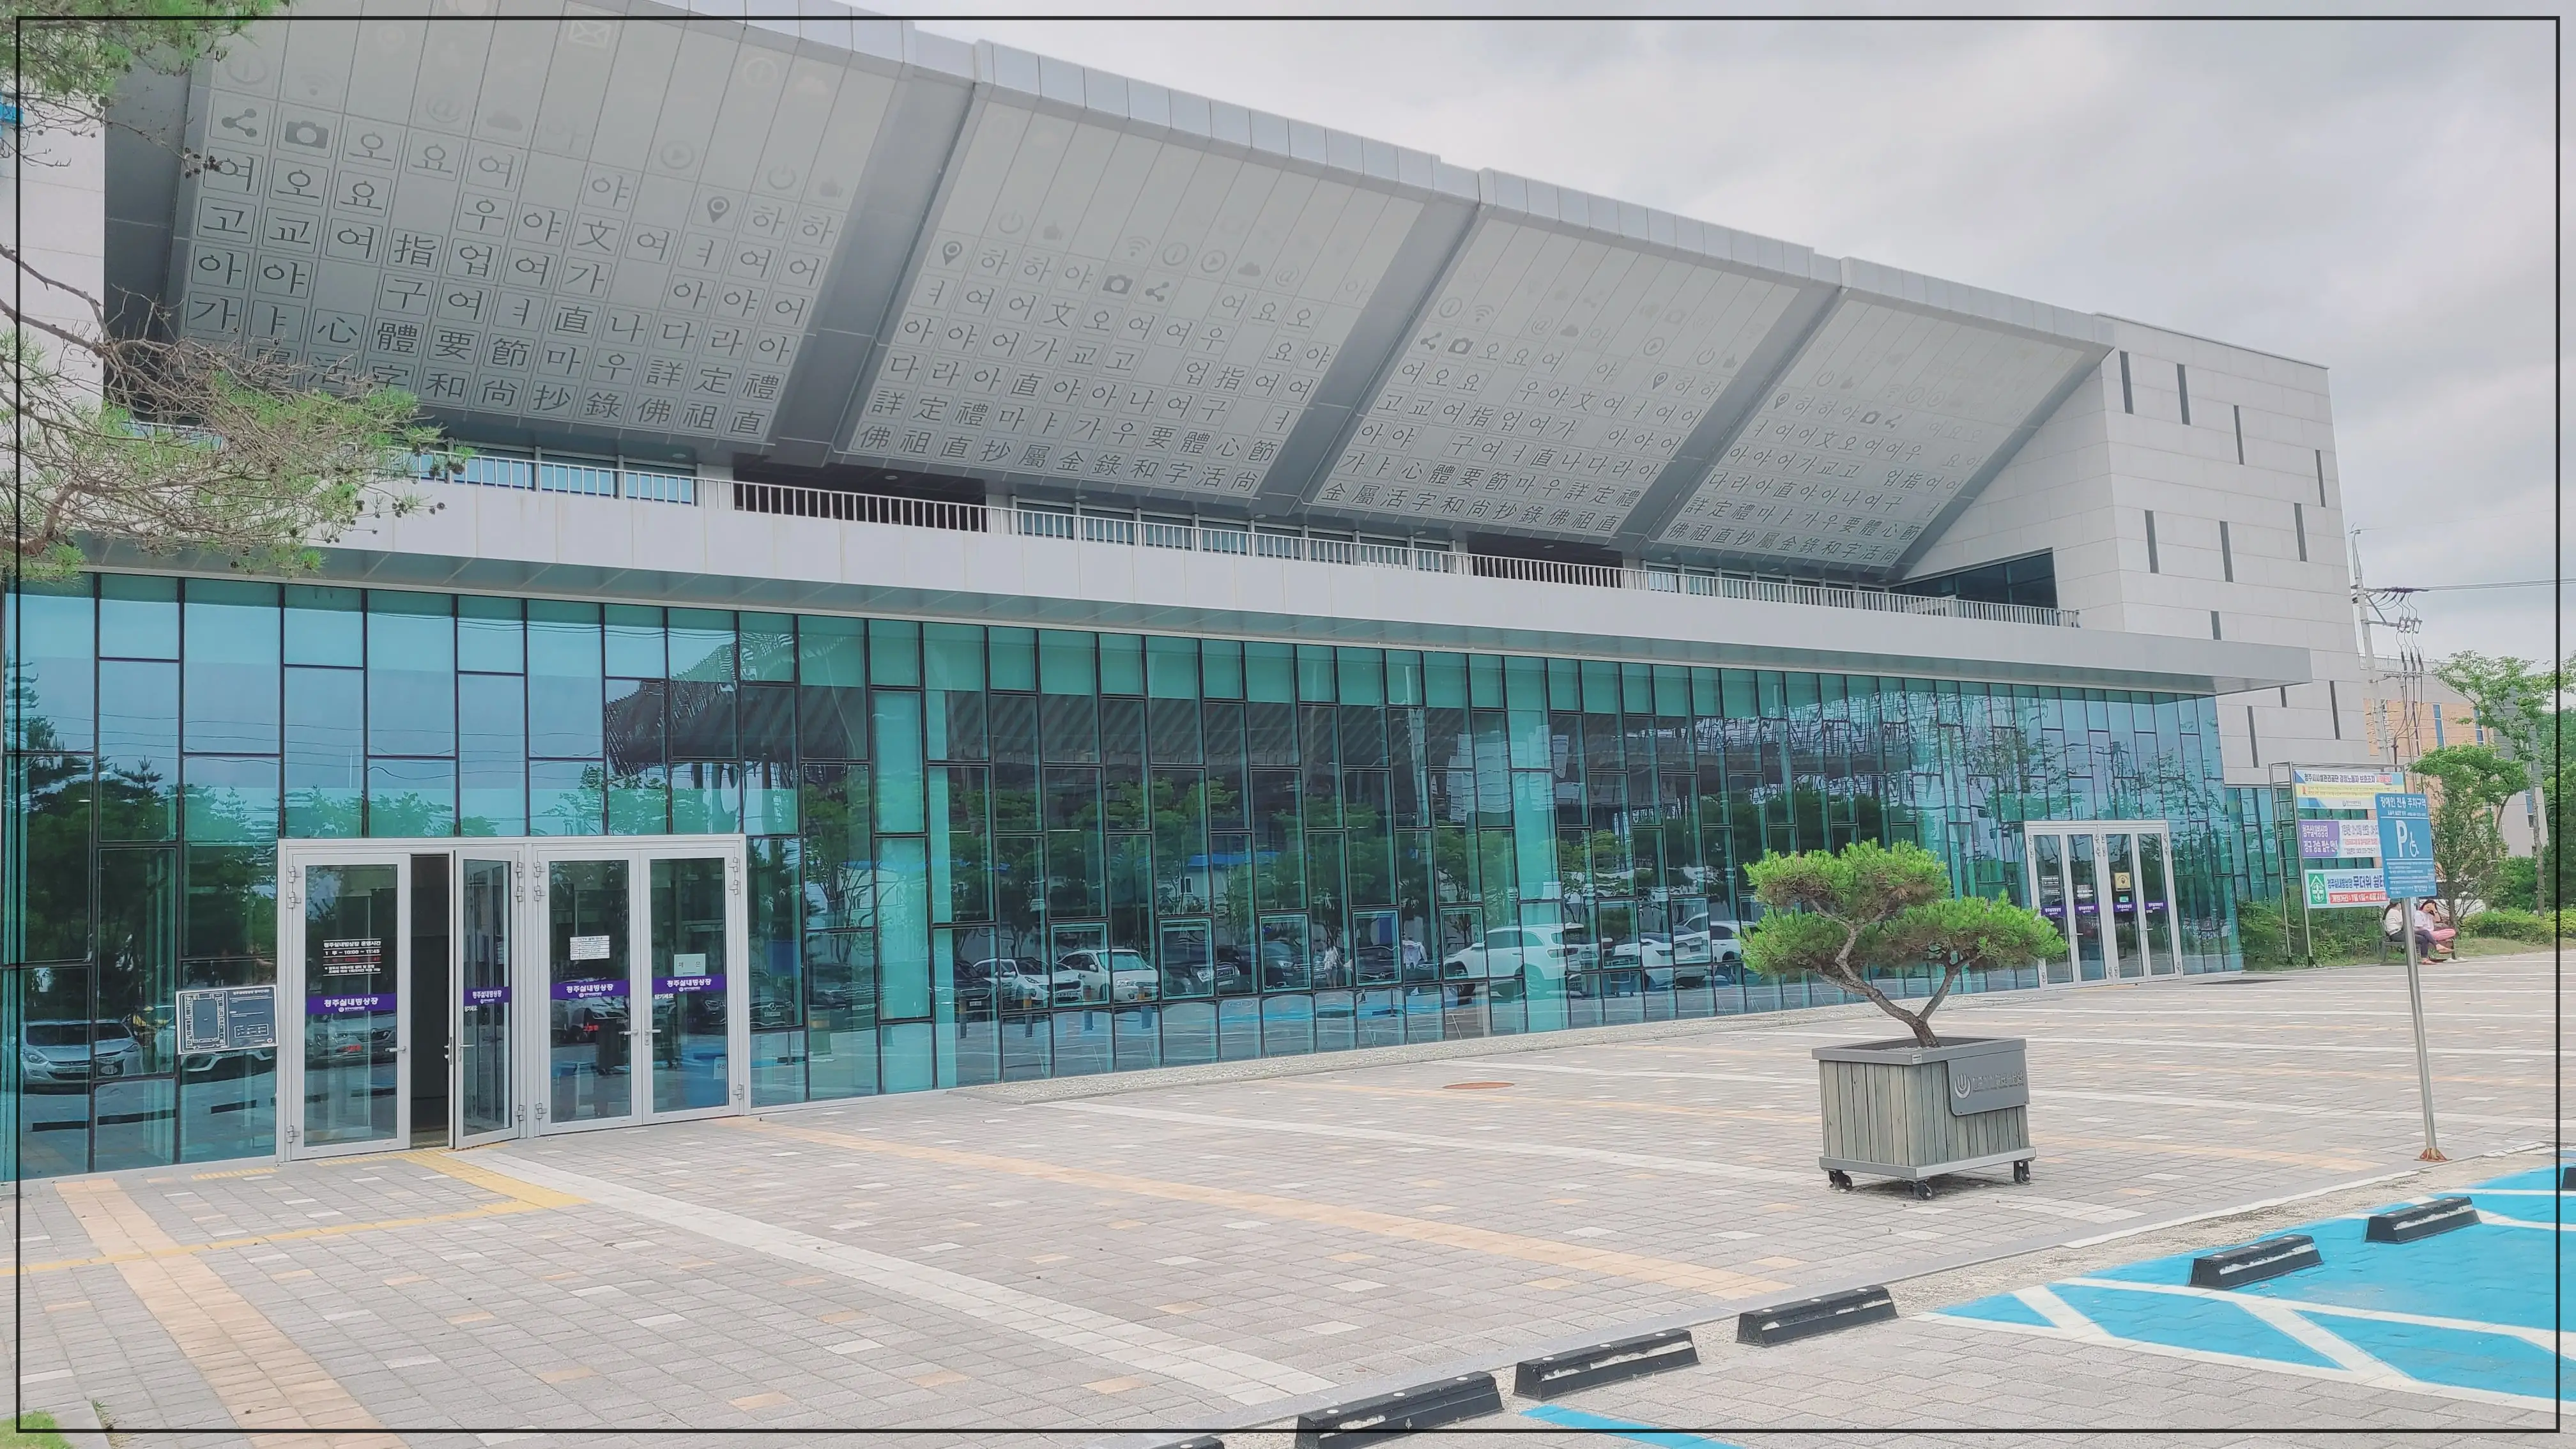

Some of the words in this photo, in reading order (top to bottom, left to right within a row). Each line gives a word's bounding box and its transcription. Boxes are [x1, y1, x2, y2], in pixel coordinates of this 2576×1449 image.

[203, 206, 247, 234] 고
[268, 217, 310, 244] 교
[337, 226, 374, 258] 여
[394, 233, 436, 267] 指
[459, 245, 492, 277] 업
[515, 256, 549, 286] 여
[567, 263, 604, 293] 가
[673, 281, 707, 309] 아
[723, 289, 757, 316] 야
[775, 298, 805, 325] 어
[198, 252, 241, 284] 아
[263, 261, 305, 293] 야
[387, 279, 426, 309] 구
[448, 290, 482, 319] 여
[554, 306, 592, 334] 直
[611, 314, 644, 342] 나
[663, 321, 694, 349] 다
[711, 328, 742, 356] 라
[758, 336, 789, 362] 아
[192, 298, 236, 329] 가
[317, 316, 357, 343] 心
[435, 329, 474, 359] 要
[547, 347, 581, 374] 마
[597, 353, 632, 379] 우
[646, 360, 683, 387] 詳
[693, 367, 732, 394] 定
[425, 373, 465, 397] 和
[533, 385, 571, 410] 抄
[637, 397, 671, 424] 佛
[730, 410, 765, 434] 直
[891, 355, 918, 380] 다
[932, 361, 960, 386] 라
[974, 367, 1000, 391] 아
[1010, 372, 1043, 396] 直
[1054, 379, 1080, 402] 야
[1092, 384, 1116, 407] 아
[1130, 390, 1153, 412] 나
[1167, 395, 1192, 418] 여
[1201, 399, 1226, 420] 구
[871, 390, 905, 415] 詳
[912, 396, 947, 420] 定
[999, 408, 1024, 431] 마
[1078, 418, 1101, 440] 가
[1112, 422, 1137, 443] 우
[1145, 426, 1176, 448] 要
[1216, 438, 1239, 456] 心
[860, 425, 891, 449] 佛
[939, 436, 972, 458] 直
[979, 440, 1010, 461] 抄
[1056, 450, 1084, 471] 金
[1130, 459, 1159, 478] 和
[1165, 463, 1193, 483] 字
[1195, 466, 1225, 487] 活
[1343, 453, 1365, 473] 가
[1401, 462, 1422, 479] 心
[1457, 468, 1484, 487] 要
[1515, 475, 1536, 494] 마
[1542, 479, 1560, 497] 우
[1563, 482, 1590, 500] 詳
[1588, 486, 1615, 503] 定
[1321, 482, 1346, 501] 金
[1379, 488, 1407, 507] 活
[1411, 492, 1437, 510] 字
[1439, 496, 1464, 513] 和
[1492, 502, 1517, 519] 抄
[1546, 509, 1570, 526] 佛
[1594, 515, 1620, 531] 直
[1666, 522, 1689, 539] 佛
[1710, 528, 1735, 543] 直
[1733, 530, 1755, 545] 抄
[1776, 535, 1796, 551] 金
[1821, 540, 1841, 555] 和
[1842, 542, 1862, 558] 字
[1862, 545, 1882, 560] 活
[2380, 797, 2396, 808] 장애인
[2396, 797, 2406, 809] 전용
[2407, 797, 2426, 809] 주차구역
[2396, 820, 2407, 857] P
[2353, 875, 2372, 889] 무더위
[324, 997, 379, 1007] 청주실내빙상장
[472, 990, 502, 999] 청주실내빙상장
[566, 984, 613, 993] 청주실내빙상장
[667, 978, 712, 987] 청주실내빙상장
